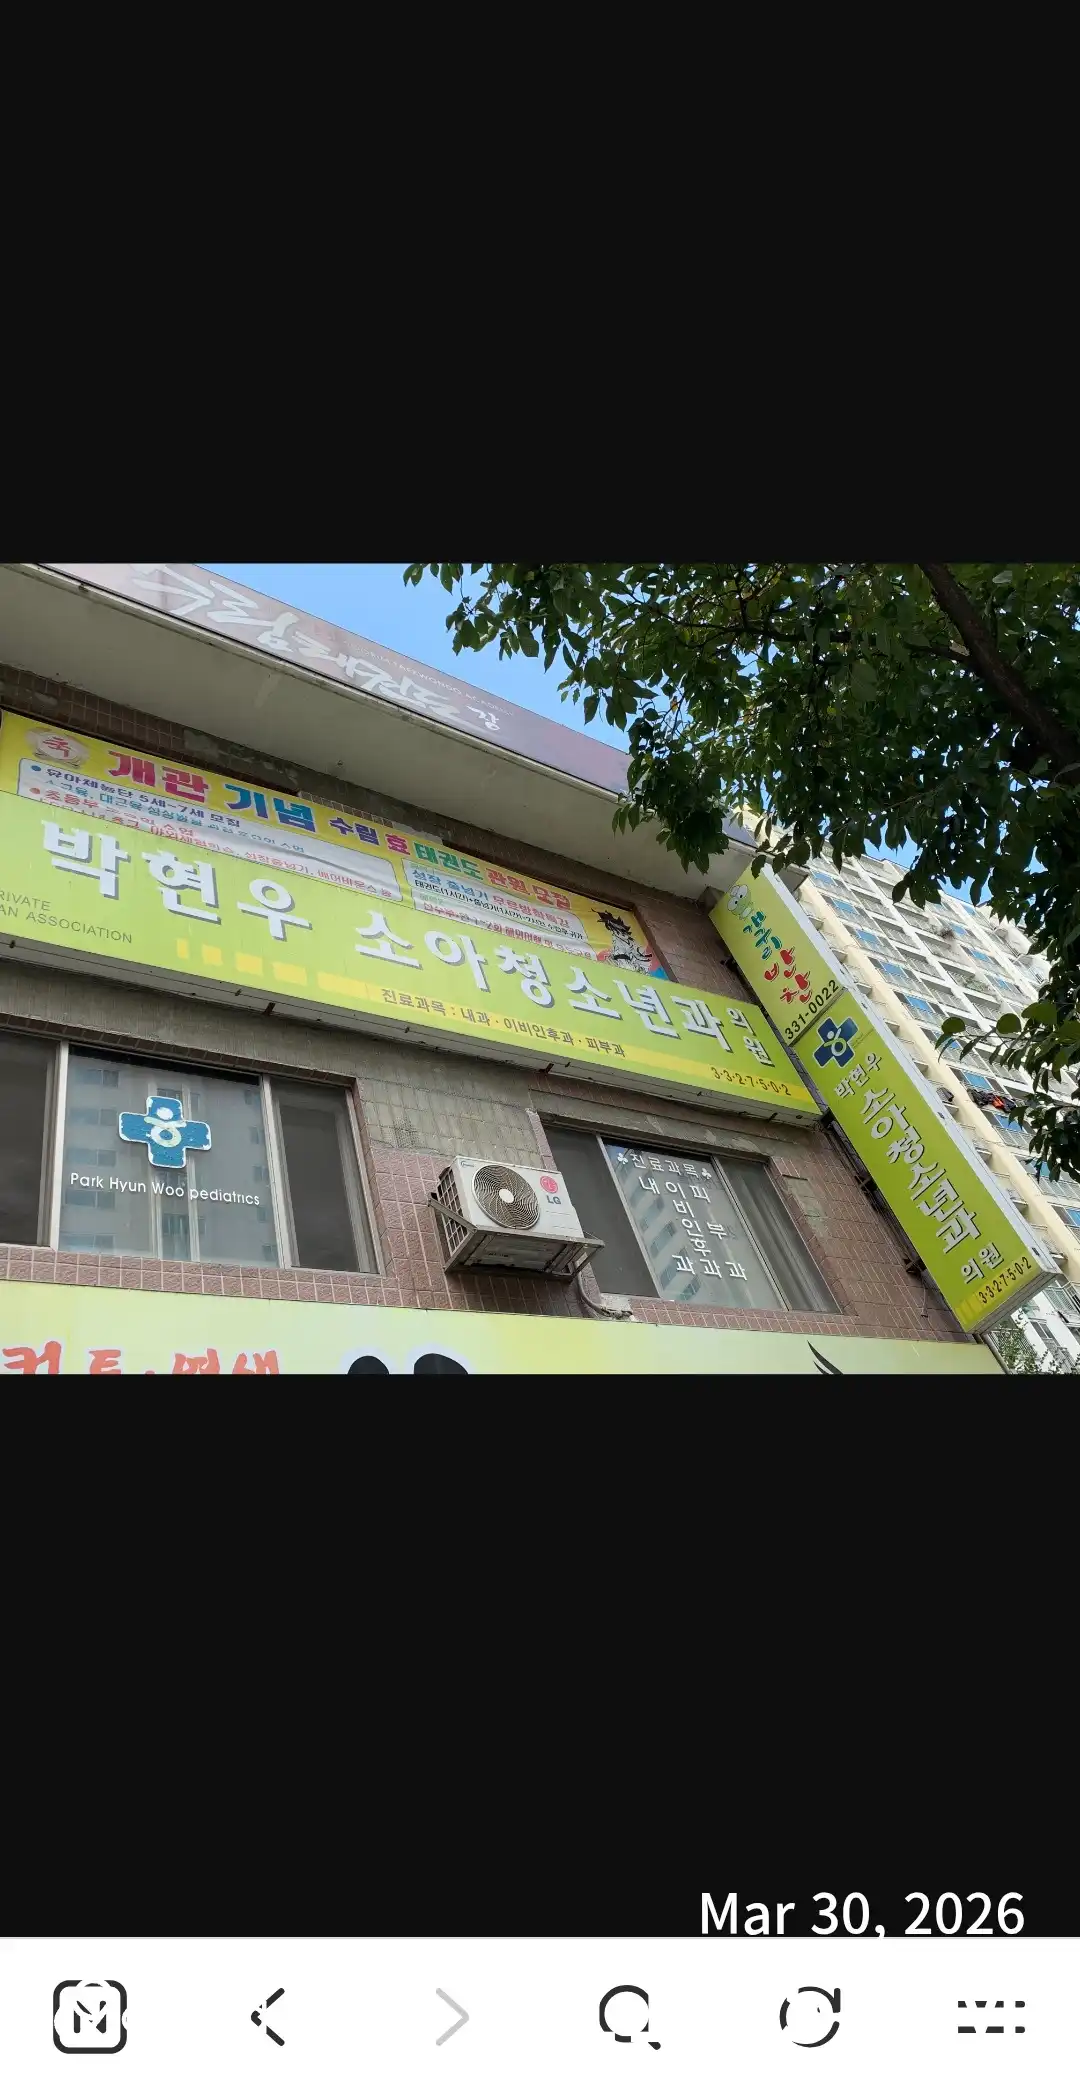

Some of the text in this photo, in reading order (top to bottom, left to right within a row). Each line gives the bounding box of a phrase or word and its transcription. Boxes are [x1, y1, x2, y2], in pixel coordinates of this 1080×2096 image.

[107, 750, 209, 803] 개관
[224, 783, 316, 833] 기념
[385, 833, 411, 855] 효
[412, 842, 484, 881] 태권도
[41, 820, 314, 942] 박현우
[26, 911, 132, 944] ASSOCIATION
[355, 911, 776, 1067] 소아청소년과 의원
[784, 979, 840, 1041] 331-0022
[381, 989, 626, 1058] 진료과목 내과 이비인후과 피부과
[833, 1052, 883, 1099] 박현우
[70, 1172, 260, 1206] Park Hyun Woo pediatrics
[630, 1153, 698, 1179] 진료과목
[859, 1087, 982, 1255] 소아청소년과
[546, 1195, 562, 1205] LG
[960, 1242, 1006, 1285] 의원
